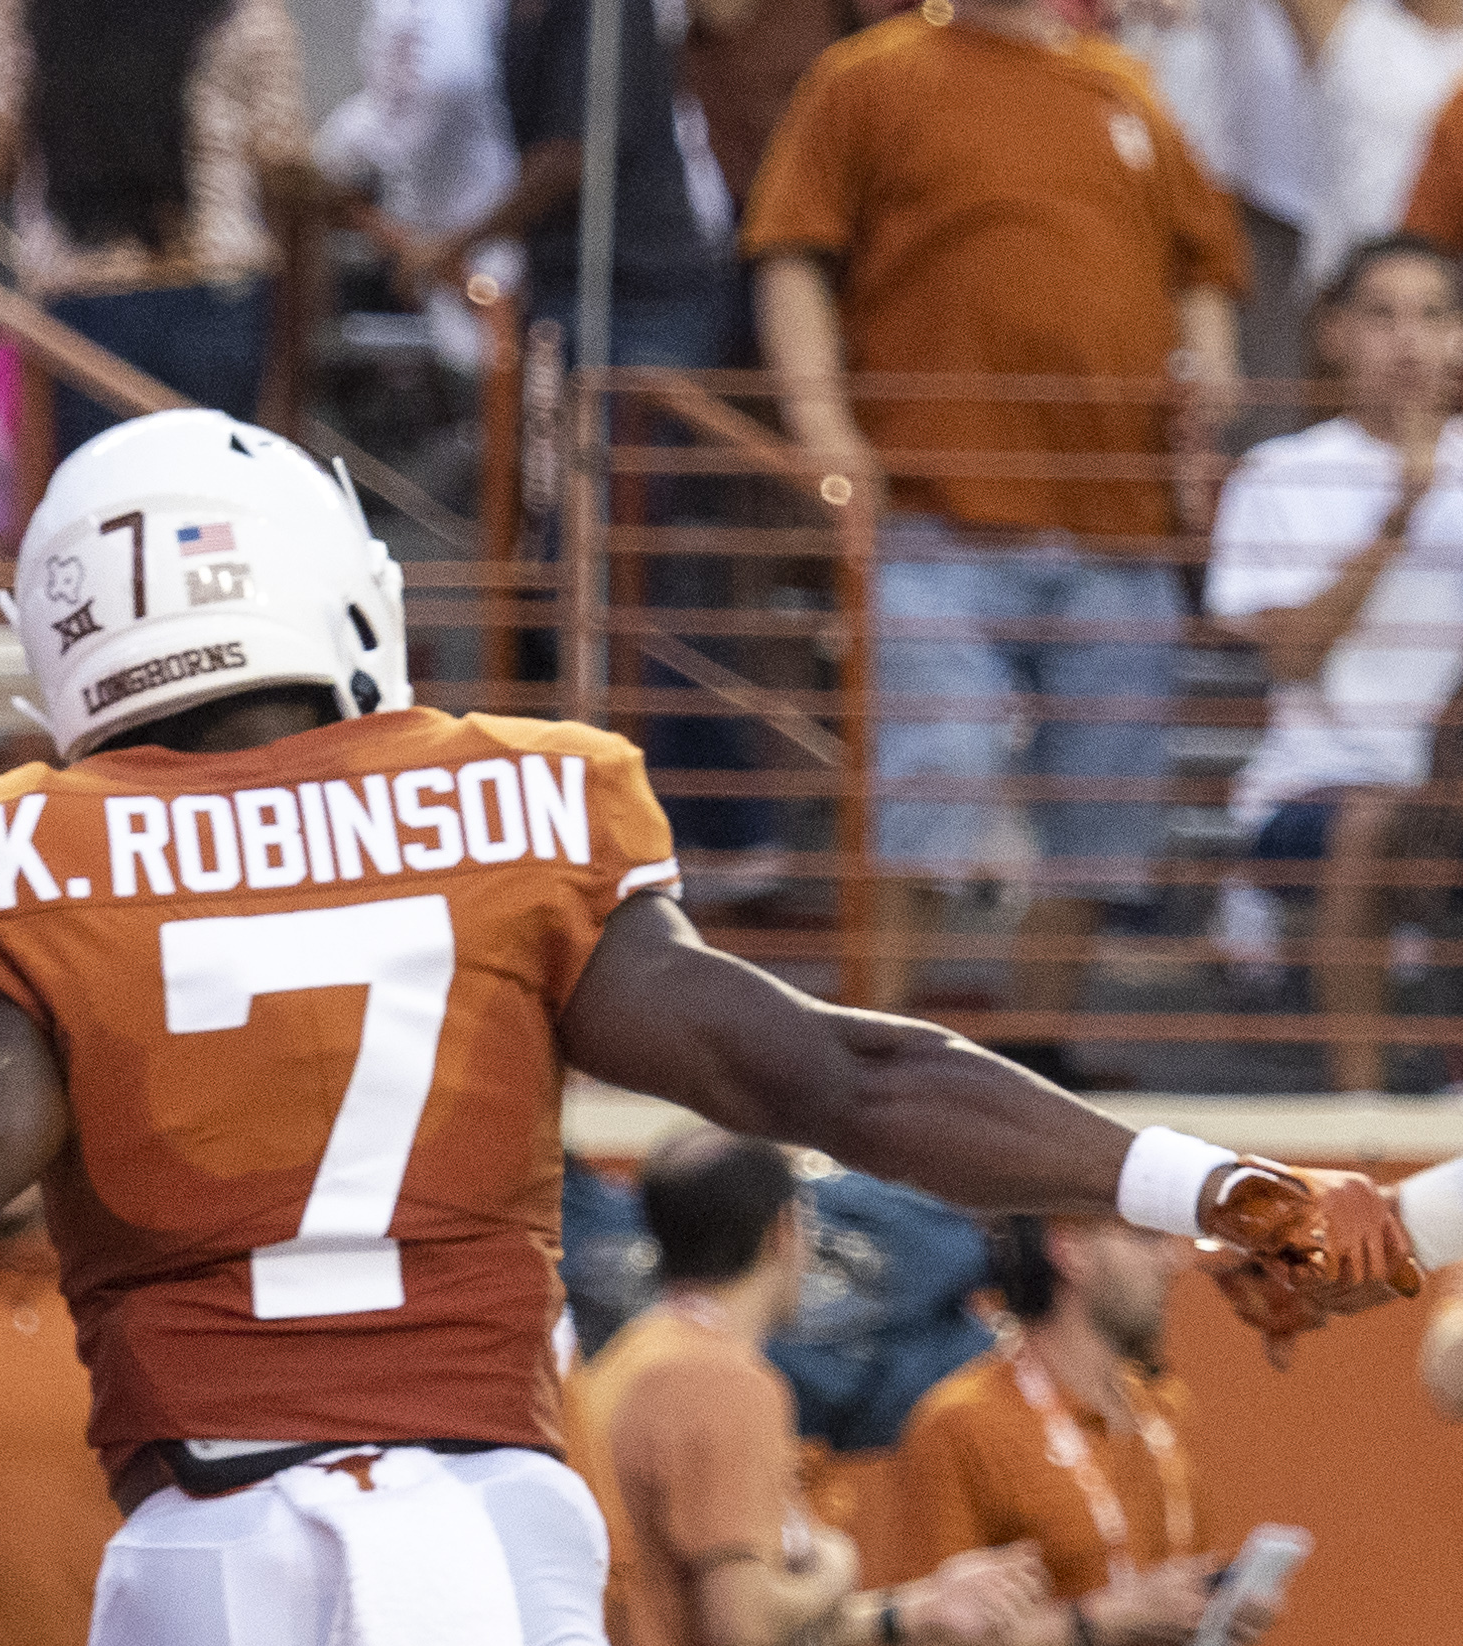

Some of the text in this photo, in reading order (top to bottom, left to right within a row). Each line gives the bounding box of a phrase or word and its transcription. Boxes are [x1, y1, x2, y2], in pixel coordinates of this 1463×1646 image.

[100, 511, 146, 619] 7
[83, 642, 247, 715] LONGHORNS
[104, 755, 592, 898] ROBINSON
[159, 894, 454, 1321] 7
